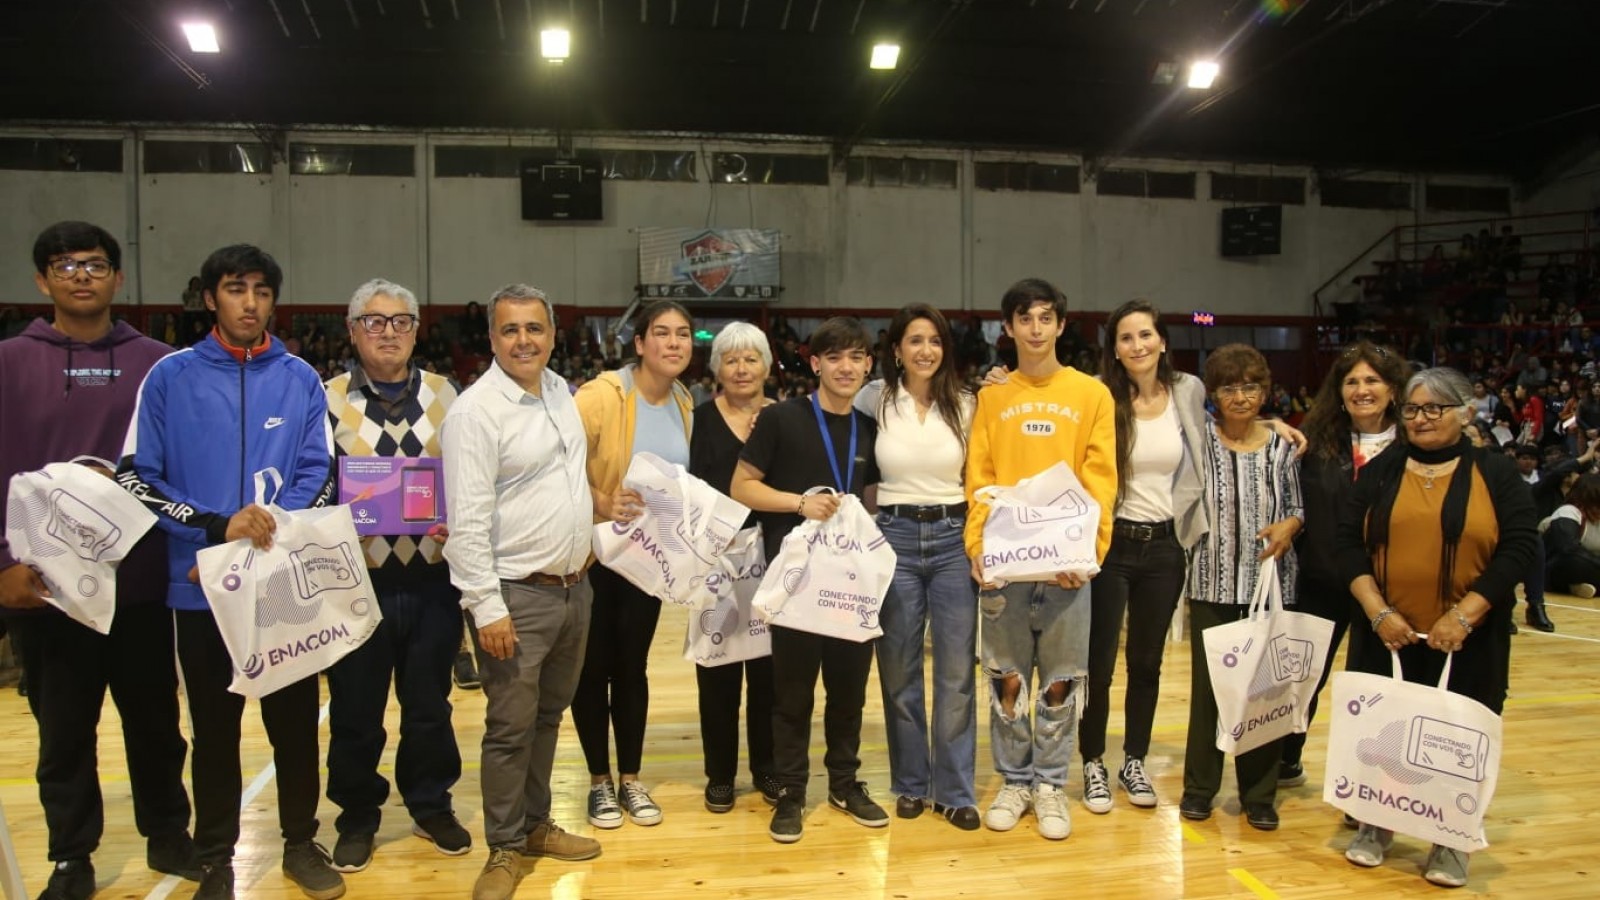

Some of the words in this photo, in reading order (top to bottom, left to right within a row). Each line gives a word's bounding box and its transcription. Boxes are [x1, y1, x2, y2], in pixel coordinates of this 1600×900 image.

[1000, 402, 1082, 423] MISTRAL
[1026, 423, 1052, 433] 1976
[162, 501, 195, 524] AIR
[629, 528, 677, 588] ENACOM
[983, 544, 1060, 568] ENACOM
[818, 598, 836, 609] CON
[838, 601, 856, 612] VOS
[819, 589, 878, 606] CONECTANDO
[268, 623, 350, 667] ENACOM
[1422, 740, 1438, 750] CON
[1423, 733, 1472, 750] CONECTANDO
[1358, 784, 1444, 822] ENACOM
